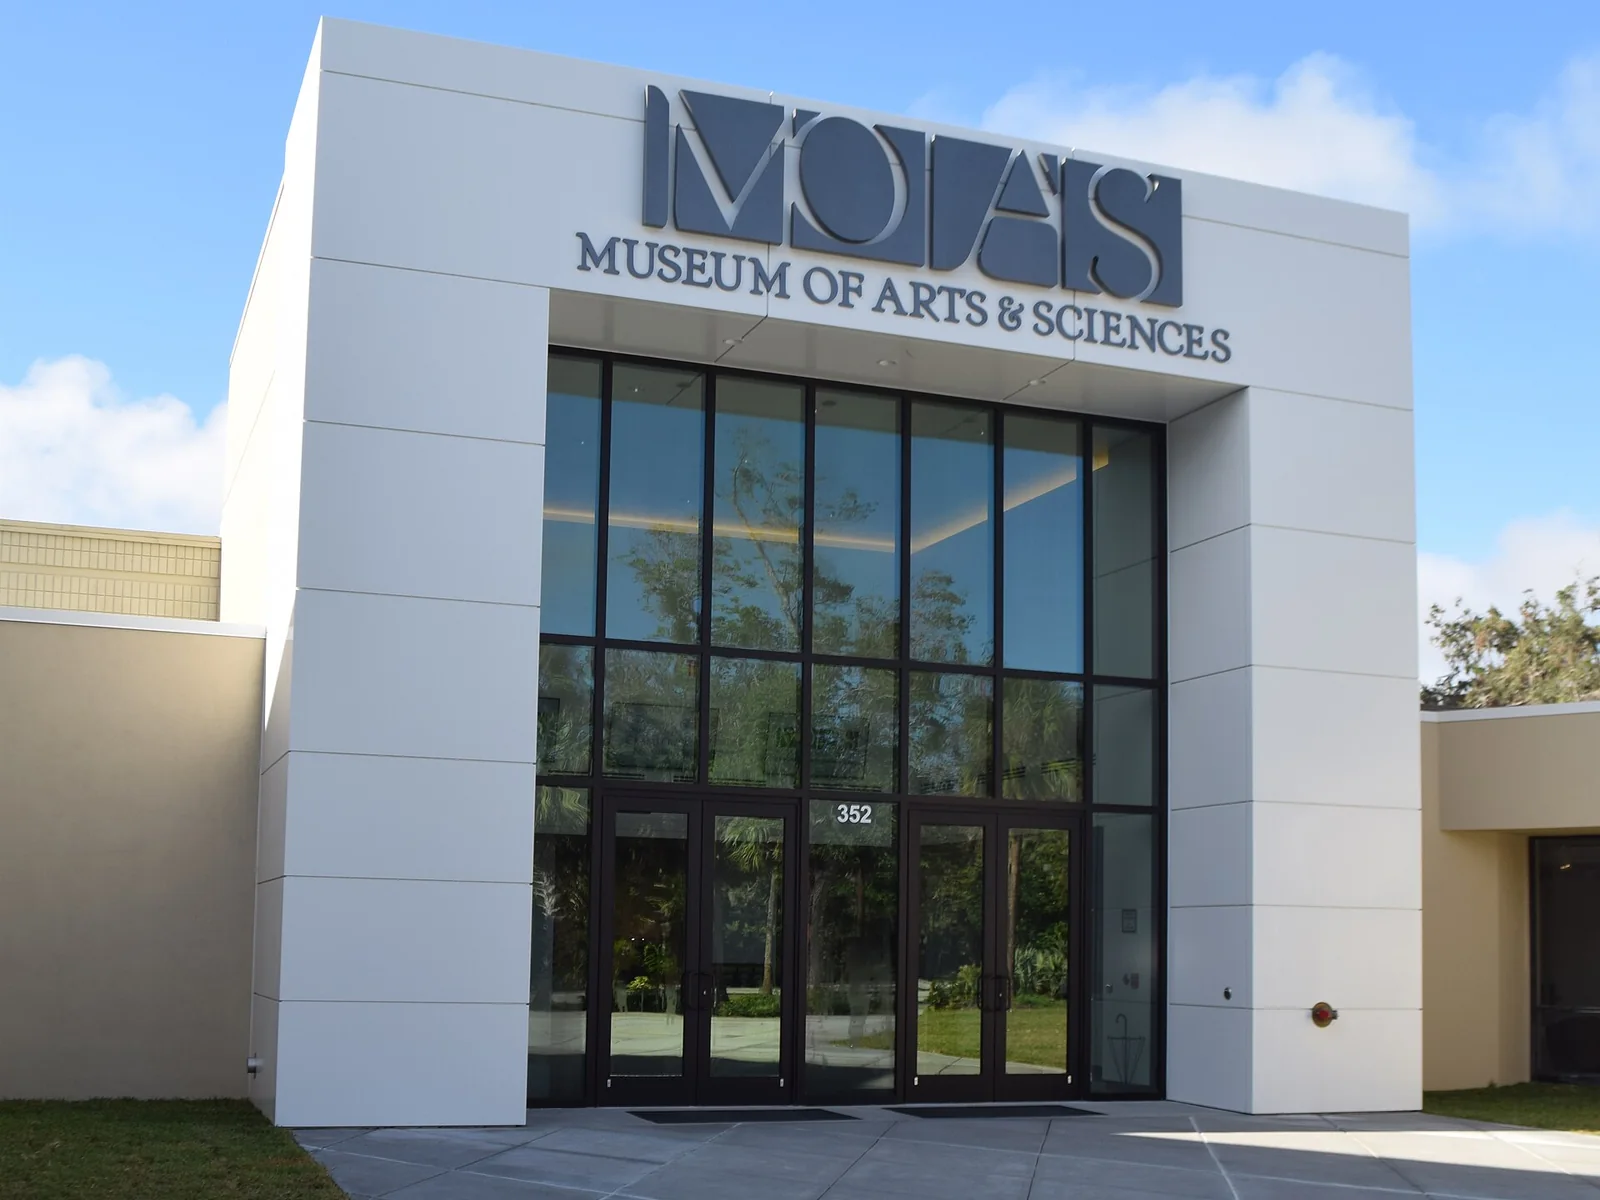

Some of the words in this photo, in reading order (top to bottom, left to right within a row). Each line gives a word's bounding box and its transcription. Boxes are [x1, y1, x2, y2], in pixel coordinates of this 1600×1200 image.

[642, 85, 1182, 306] MOAS
[576, 231, 791, 299] MUSEUM
[803, 266, 865, 308] OF
[871, 277, 988, 327] ARTS
[997, 295, 1025, 332] &
[1032, 300, 1232, 363] SCIENCES
[837, 804, 872, 824] 352
